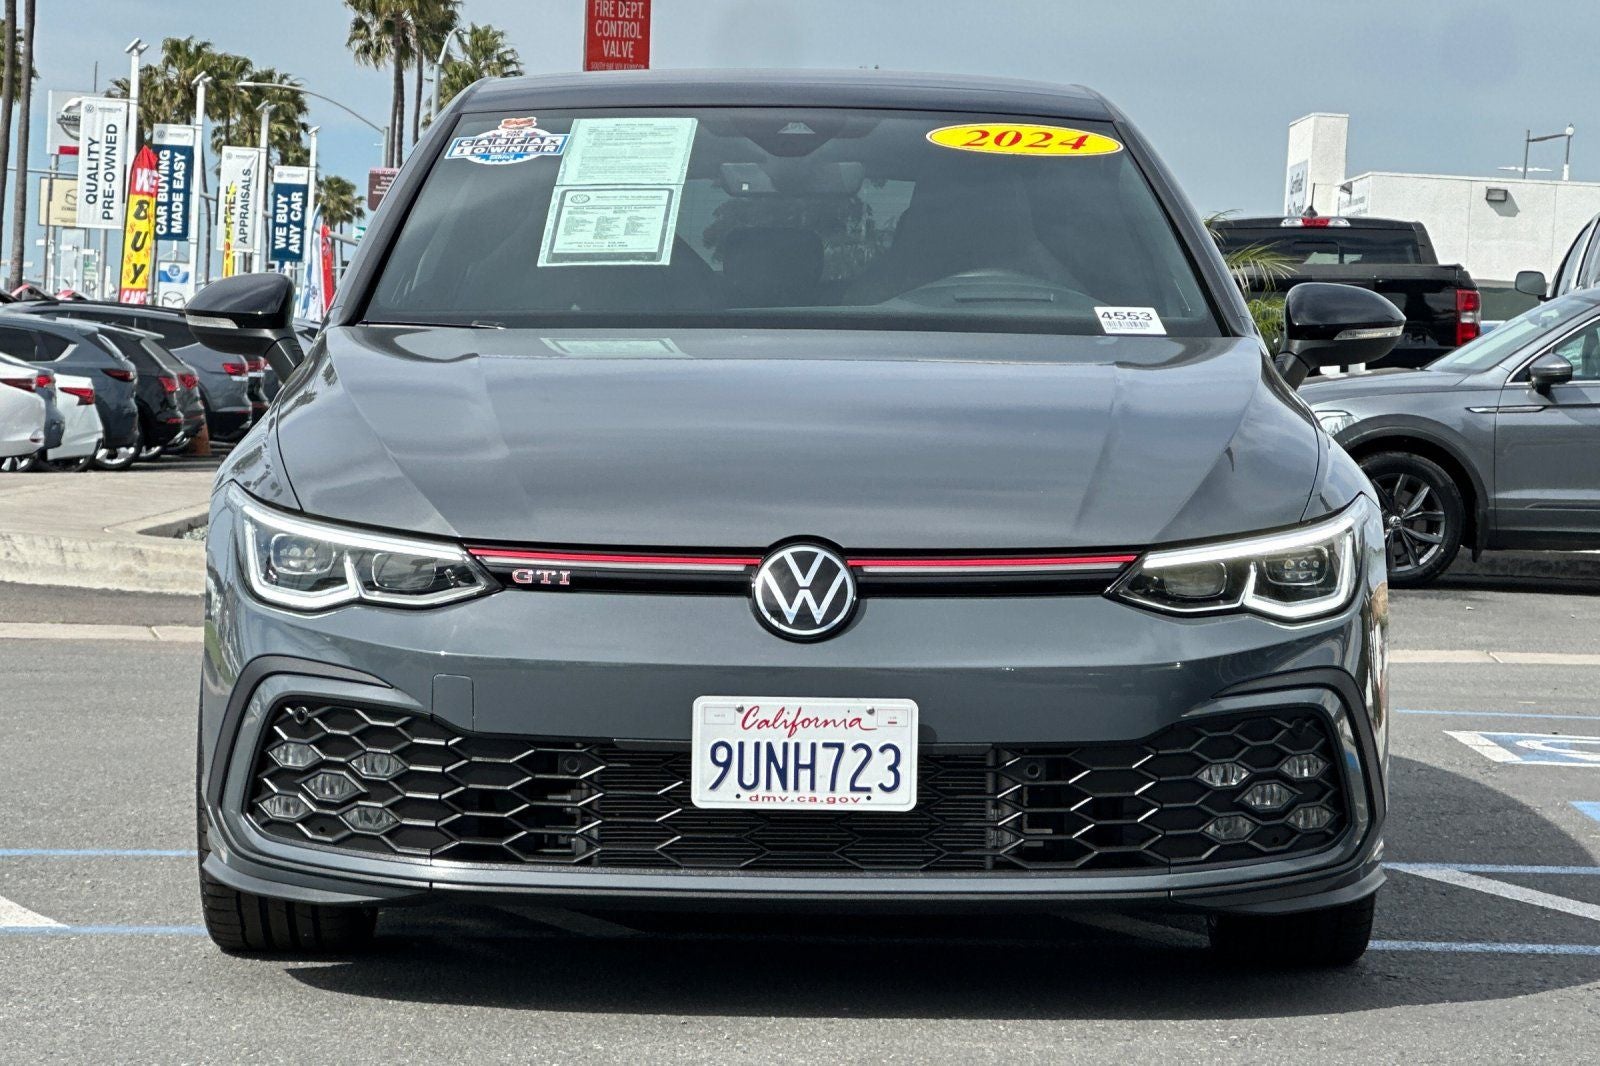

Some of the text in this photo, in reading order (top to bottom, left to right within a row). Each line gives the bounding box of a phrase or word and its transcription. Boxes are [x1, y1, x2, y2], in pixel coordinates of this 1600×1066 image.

[594, 0, 645, 19] FIRE DEPT.
[595, 20, 642, 39] CONTROL
[602, 40, 635, 58] VALVE
[459, 137, 561, 147] CARFAX
[473, 145, 557, 154] OWNER
[960, 130, 1090, 150] 2024
[86, 137, 100, 205] QUALITY
[101, 123, 118, 220] PRE-OWNED
[135, 168, 159, 193] WE
[172, 152, 186, 189] EASY
[156, 150, 171, 235] CAR BUYING
[239, 169, 252, 244] APPRAISALS
[290, 191, 303, 221] CAR
[171, 193, 183, 234] MADE
[274, 194, 289, 249] WE BUY
[288, 224, 302, 254] ANY
[1101, 311, 1153, 321] 4553
[512, 568, 571, 586] GTI
[741, 705, 877, 738] California
[709, 740, 901, 793] 9UNH723
[749, 794, 861, 805] dmv.ca.gov
